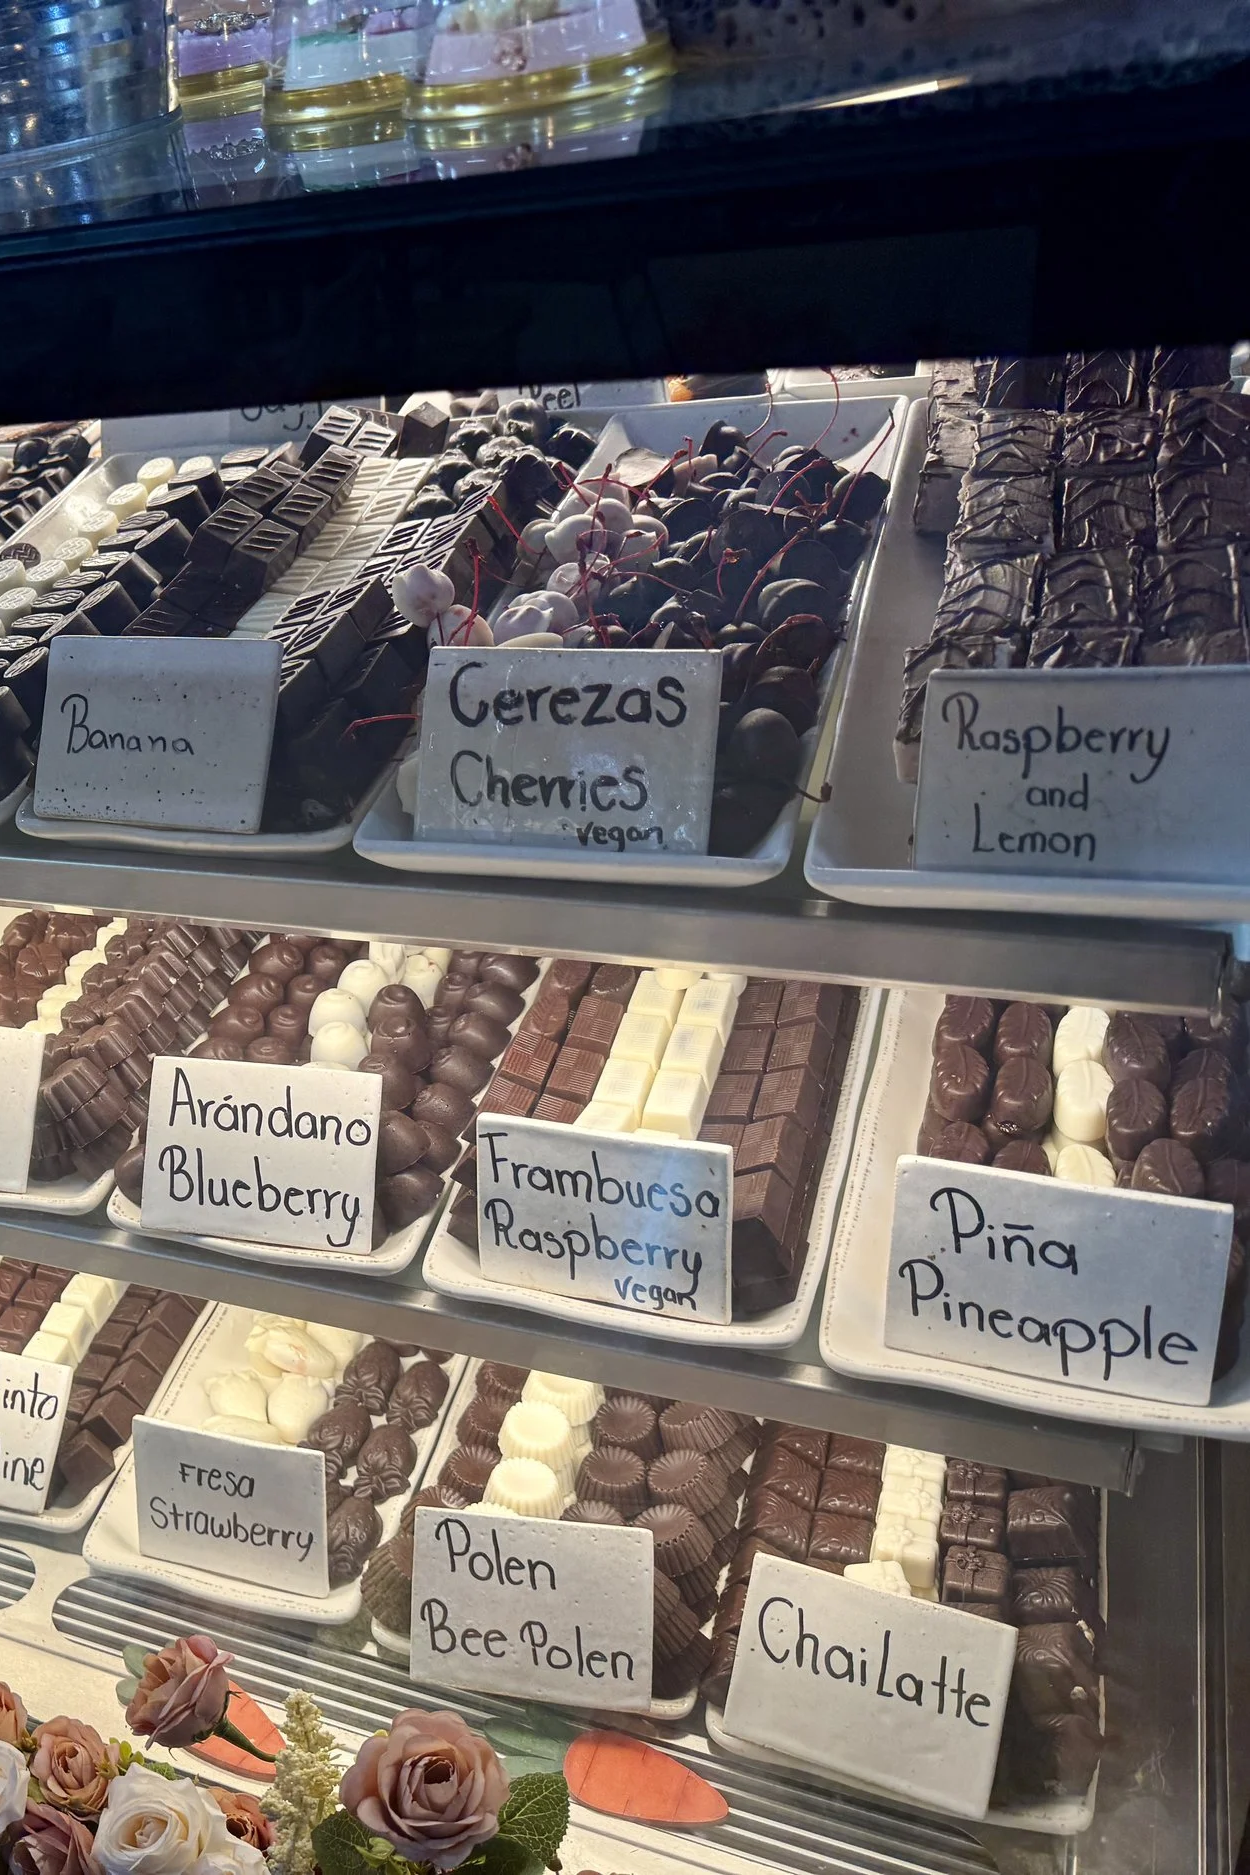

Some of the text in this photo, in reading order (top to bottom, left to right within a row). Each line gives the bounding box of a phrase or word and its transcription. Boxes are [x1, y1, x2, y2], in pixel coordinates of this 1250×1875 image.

[61, 693, 195, 756] Banana
[449, 661, 687, 728] Cerezas
[941, 691, 1170, 784] Raspberry
[450, 750, 648, 811] Cherries
[1025, 772, 1089, 811] and
[971, 802, 1097, 862] Lemon
[168, 1066, 372, 1147] Arándano
[158, 1143, 361, 1248] Blueberry
[478, 1131, 720, 1218] Frambuesa
[484, 1197, 702, 1296] Raspberry
[929, 1186, 1079, 1275] Piña
[898, 1258, 1199, 1381] Pineapple
[179, 1461, 255, 1499] Fresa
[149, 1496, 314, 1562] Strawberry
[435, 1518, 556, 1591] Polen
[420, 1597, 635, 1681] Bee Polen
